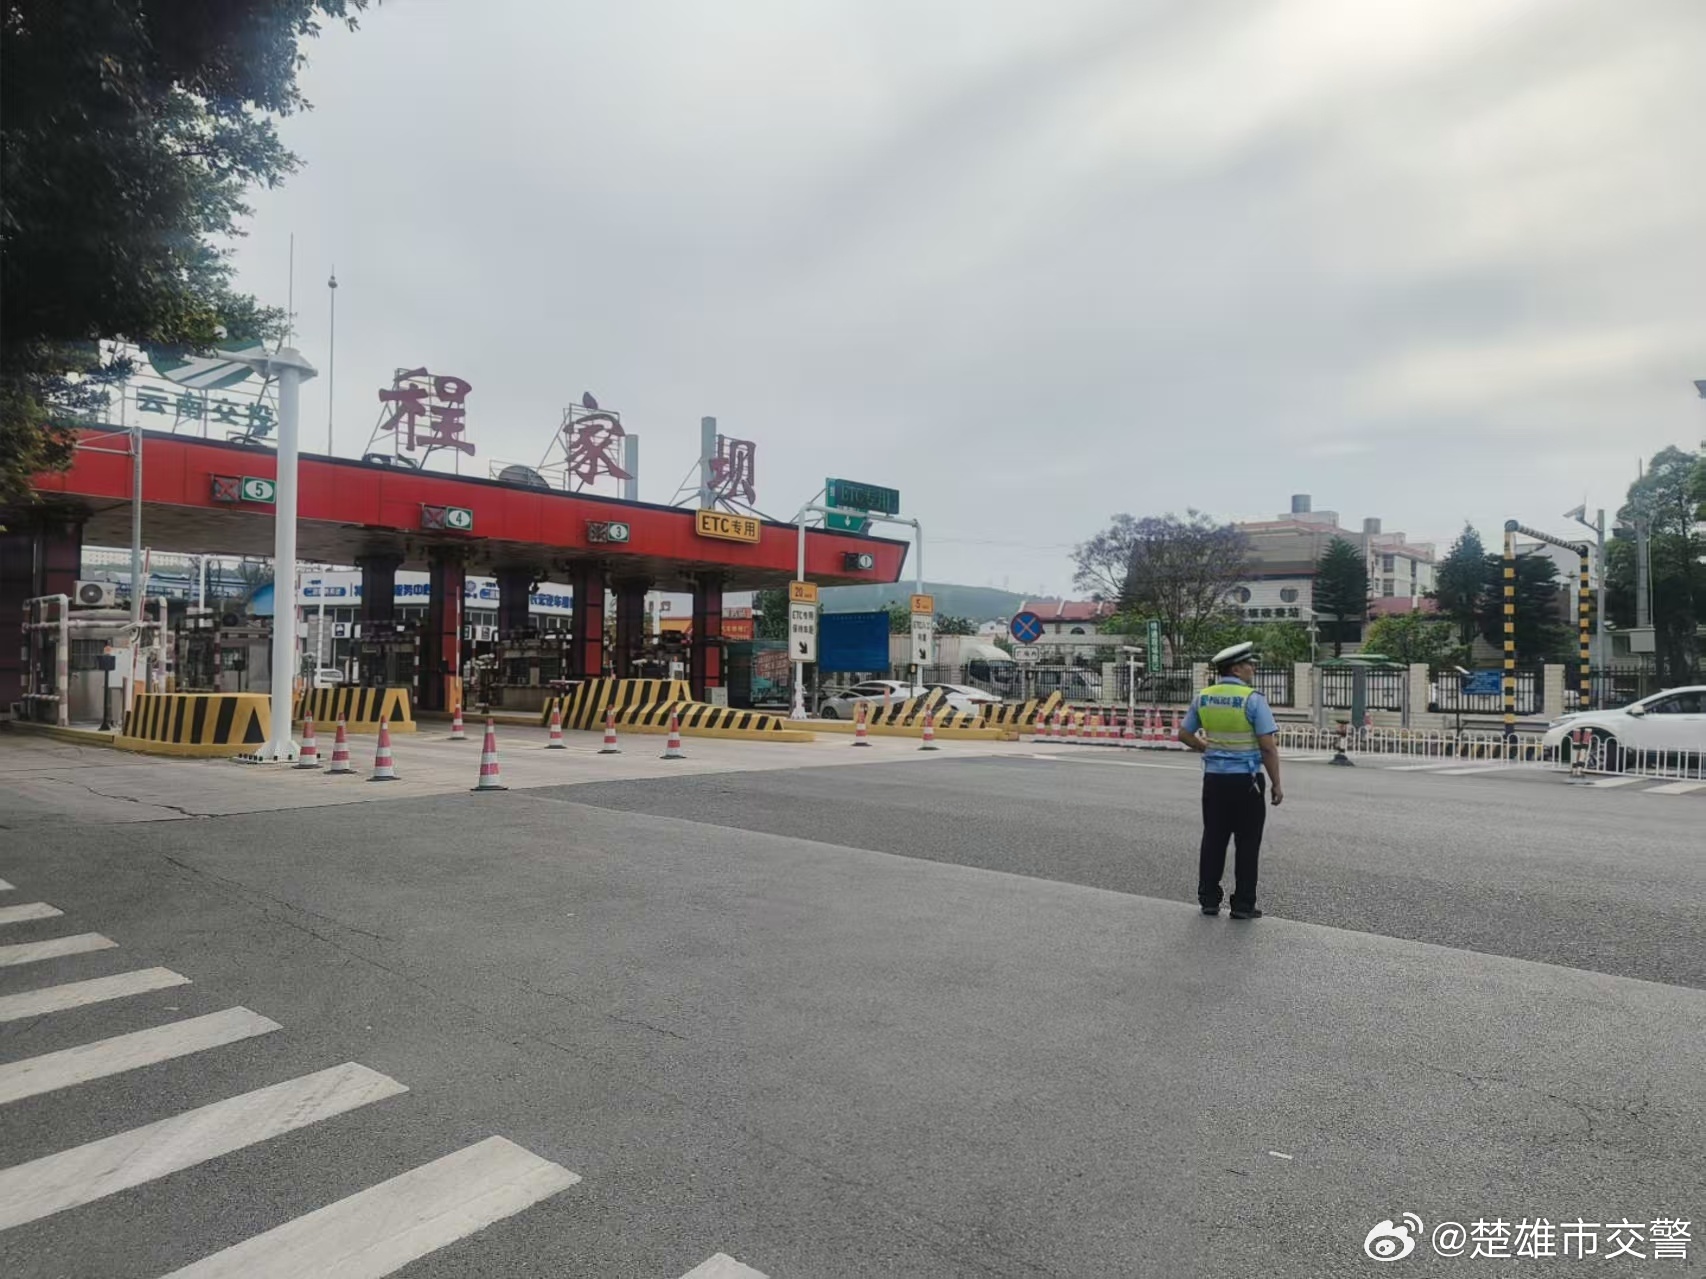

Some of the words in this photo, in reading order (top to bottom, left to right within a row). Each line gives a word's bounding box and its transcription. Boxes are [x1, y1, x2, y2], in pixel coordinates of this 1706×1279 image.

[136, 385, 278, 436] 云南交投
[702, 515, 756, 537] ETC专用
[795, 587, 803, 598] 20
[1209, 695, 1231, 705] POLICE
